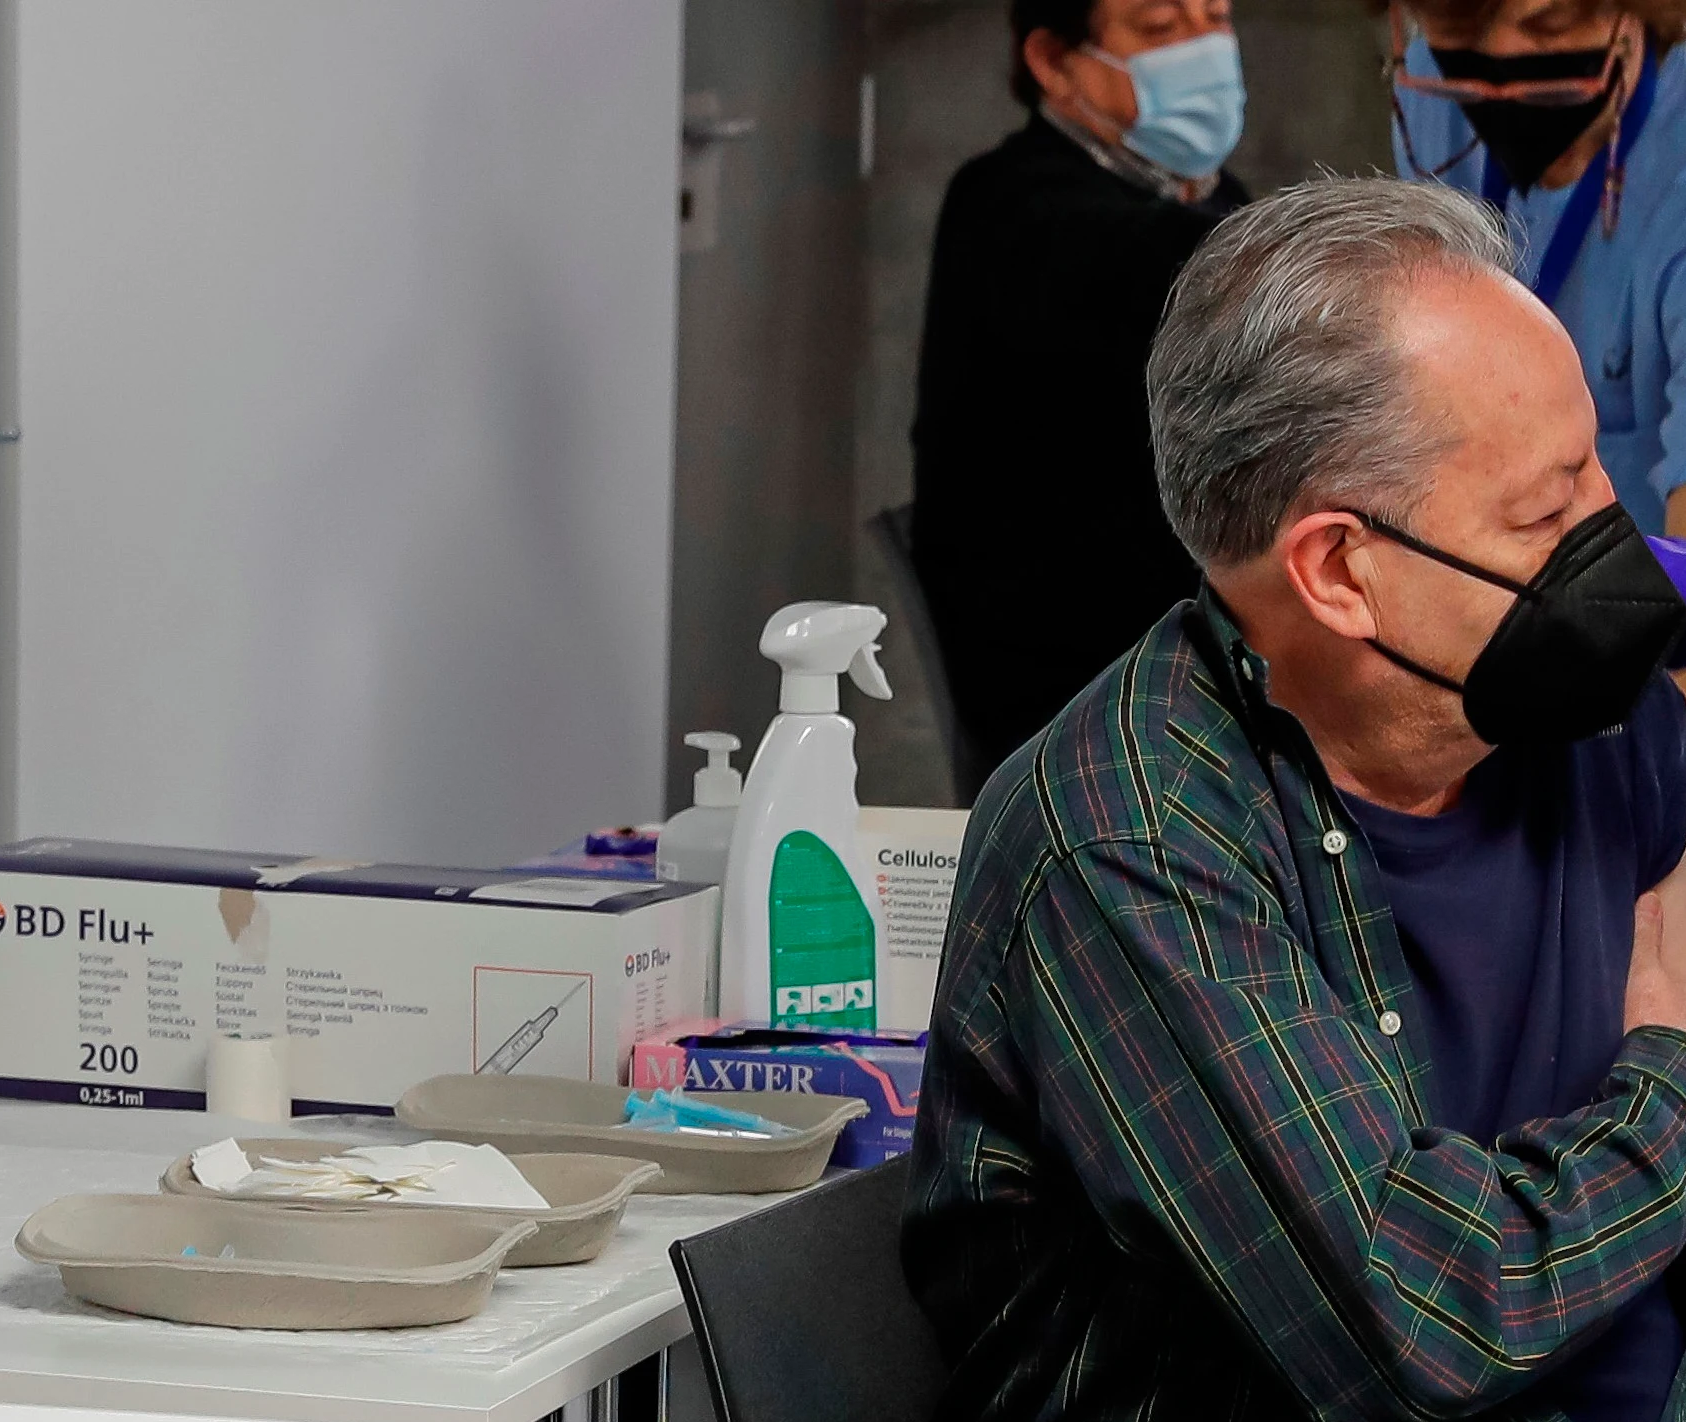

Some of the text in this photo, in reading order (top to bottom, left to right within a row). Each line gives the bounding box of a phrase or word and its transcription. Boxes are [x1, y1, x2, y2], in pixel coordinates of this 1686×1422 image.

[14, 905, 154, 945] BD Flu+
[636, 947, 671, 974] BD Flu+
[79, 1042, 139, 1074] 200
[646, 1055, 816, 1096] MAXTER
[79, 1086, 144, 1107] 0,25-1ml
